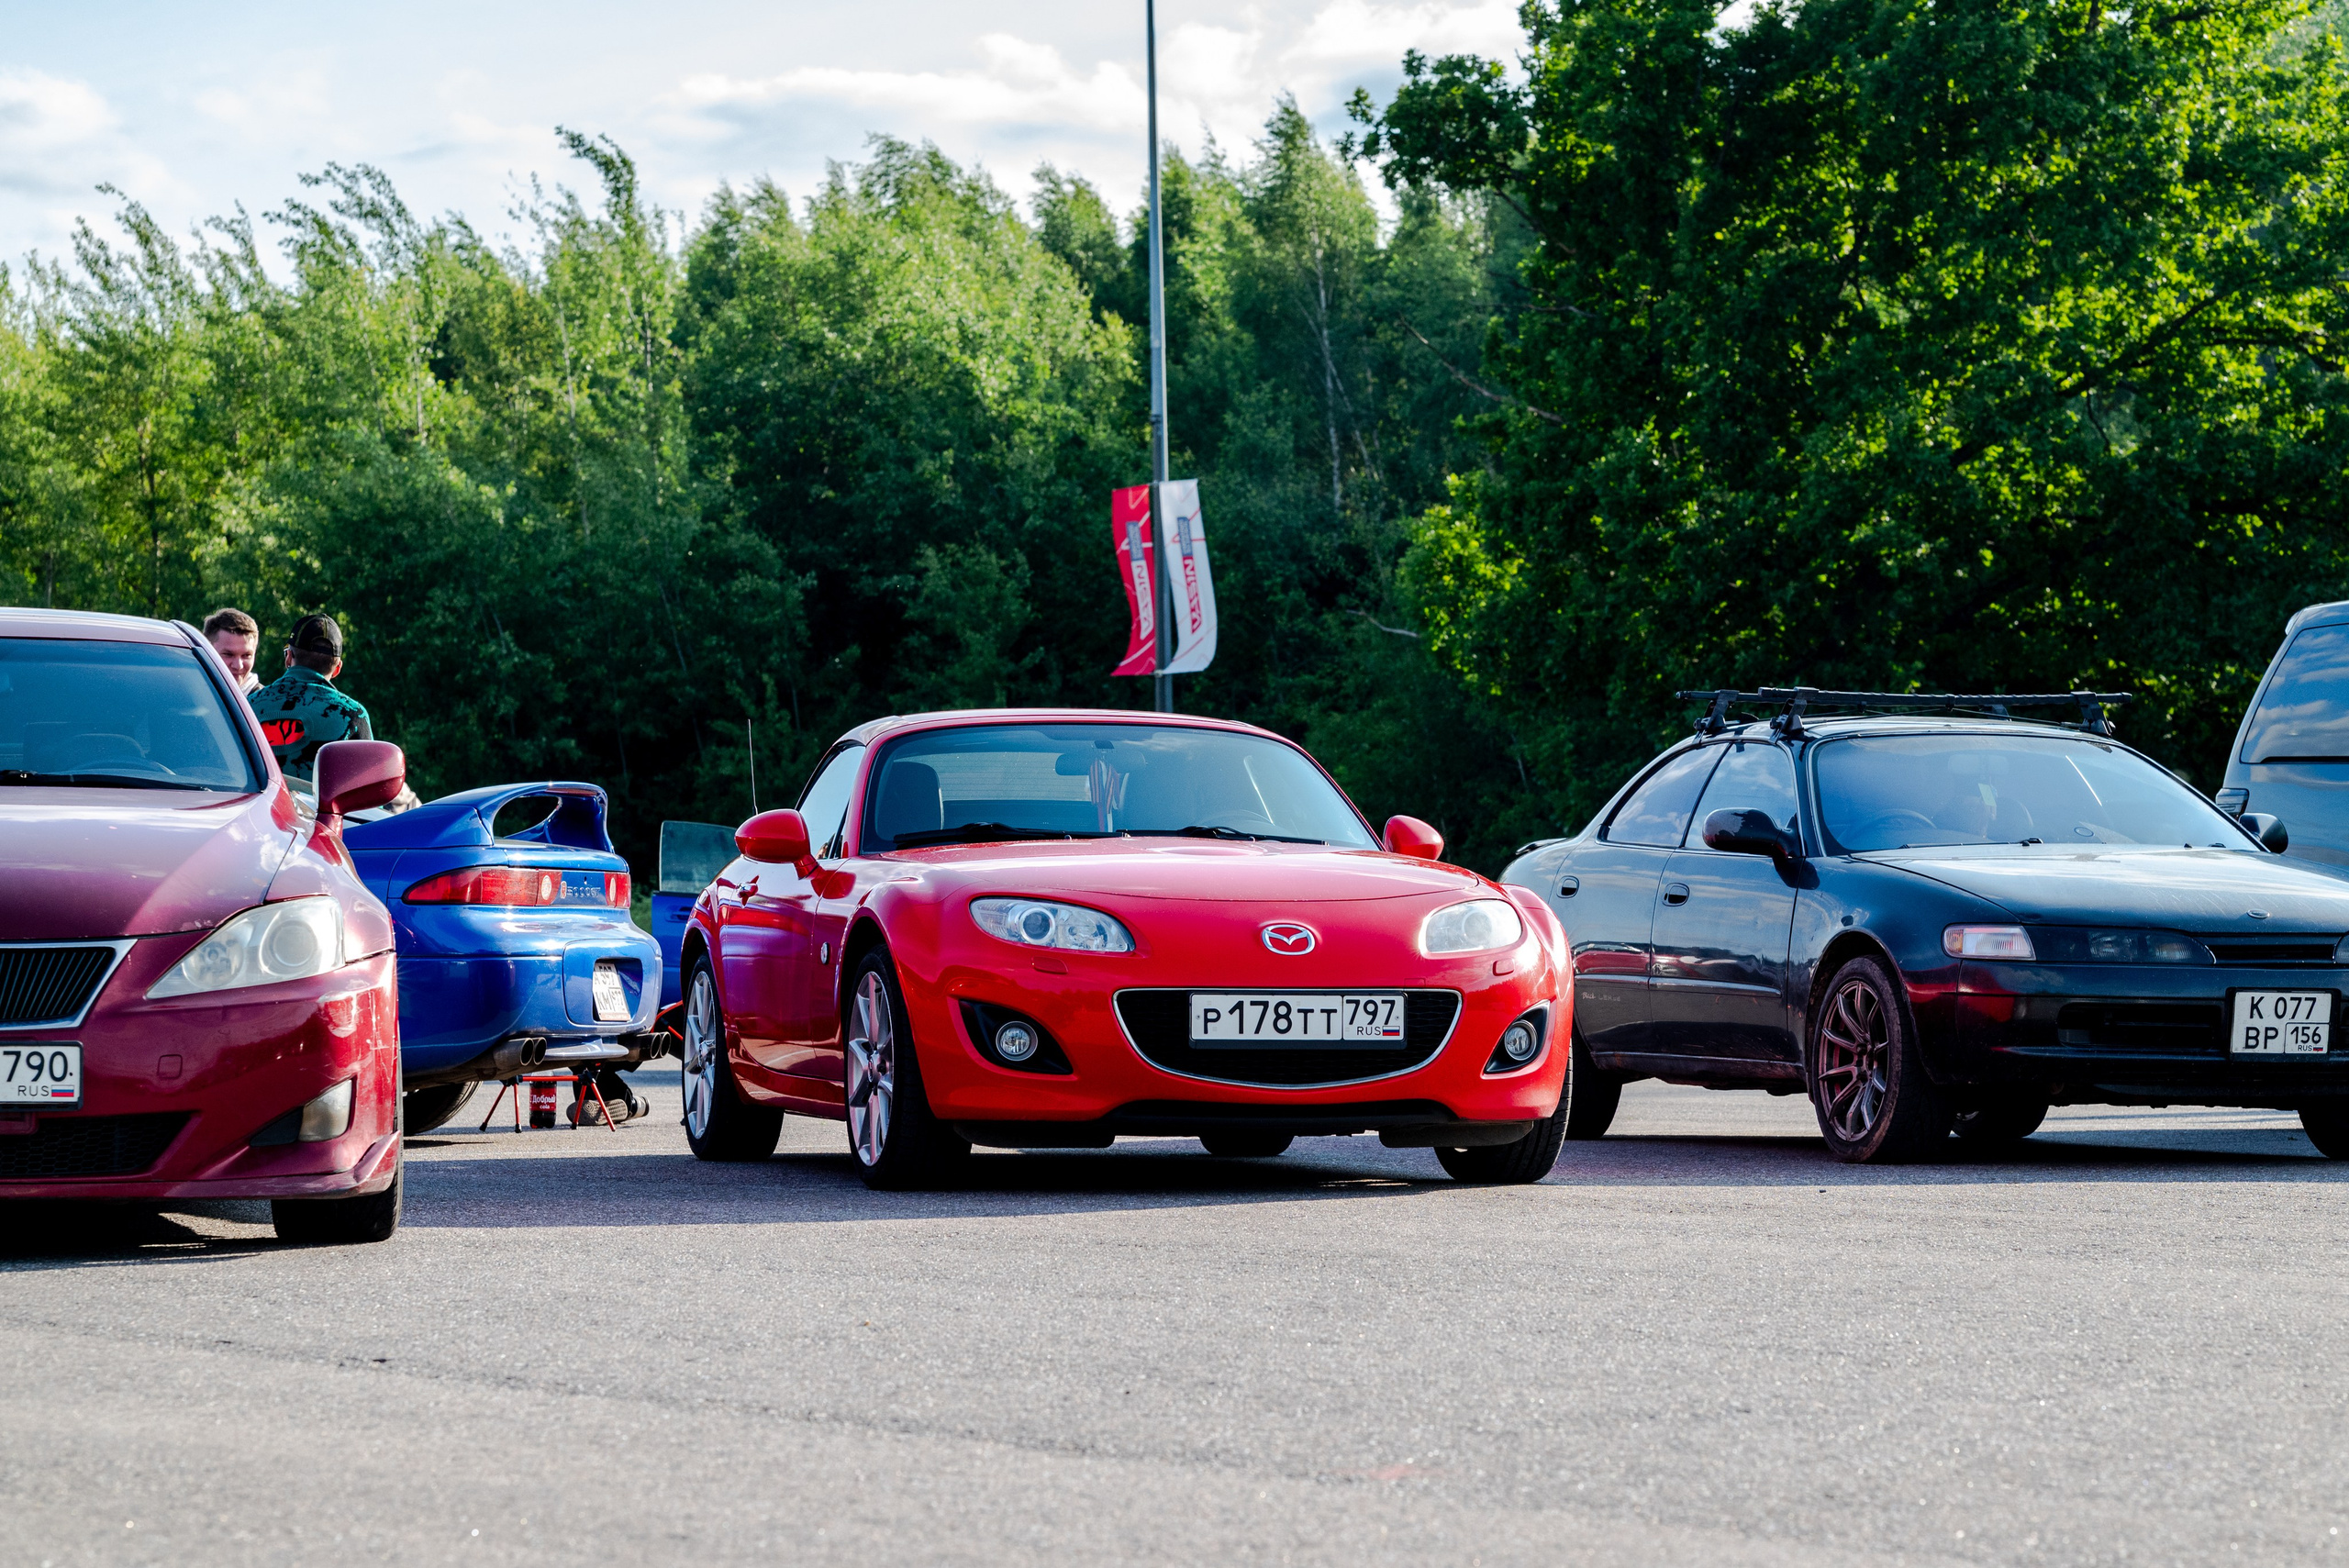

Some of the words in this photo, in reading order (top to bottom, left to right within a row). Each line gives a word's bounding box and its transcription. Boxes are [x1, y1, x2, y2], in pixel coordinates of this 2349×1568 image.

[1345, 999, 1397, 1026] 797
[2274, 996, 2317, 1020] 077
[1357, 1026, 1382, 1036] RUS
[2290, 1026, 2321, 1045] 156
[3, 1051, 69, 1082] 790
[17, 1084, 50, 1096] RUS
[532, 1095, 556, 1104] Добрый
